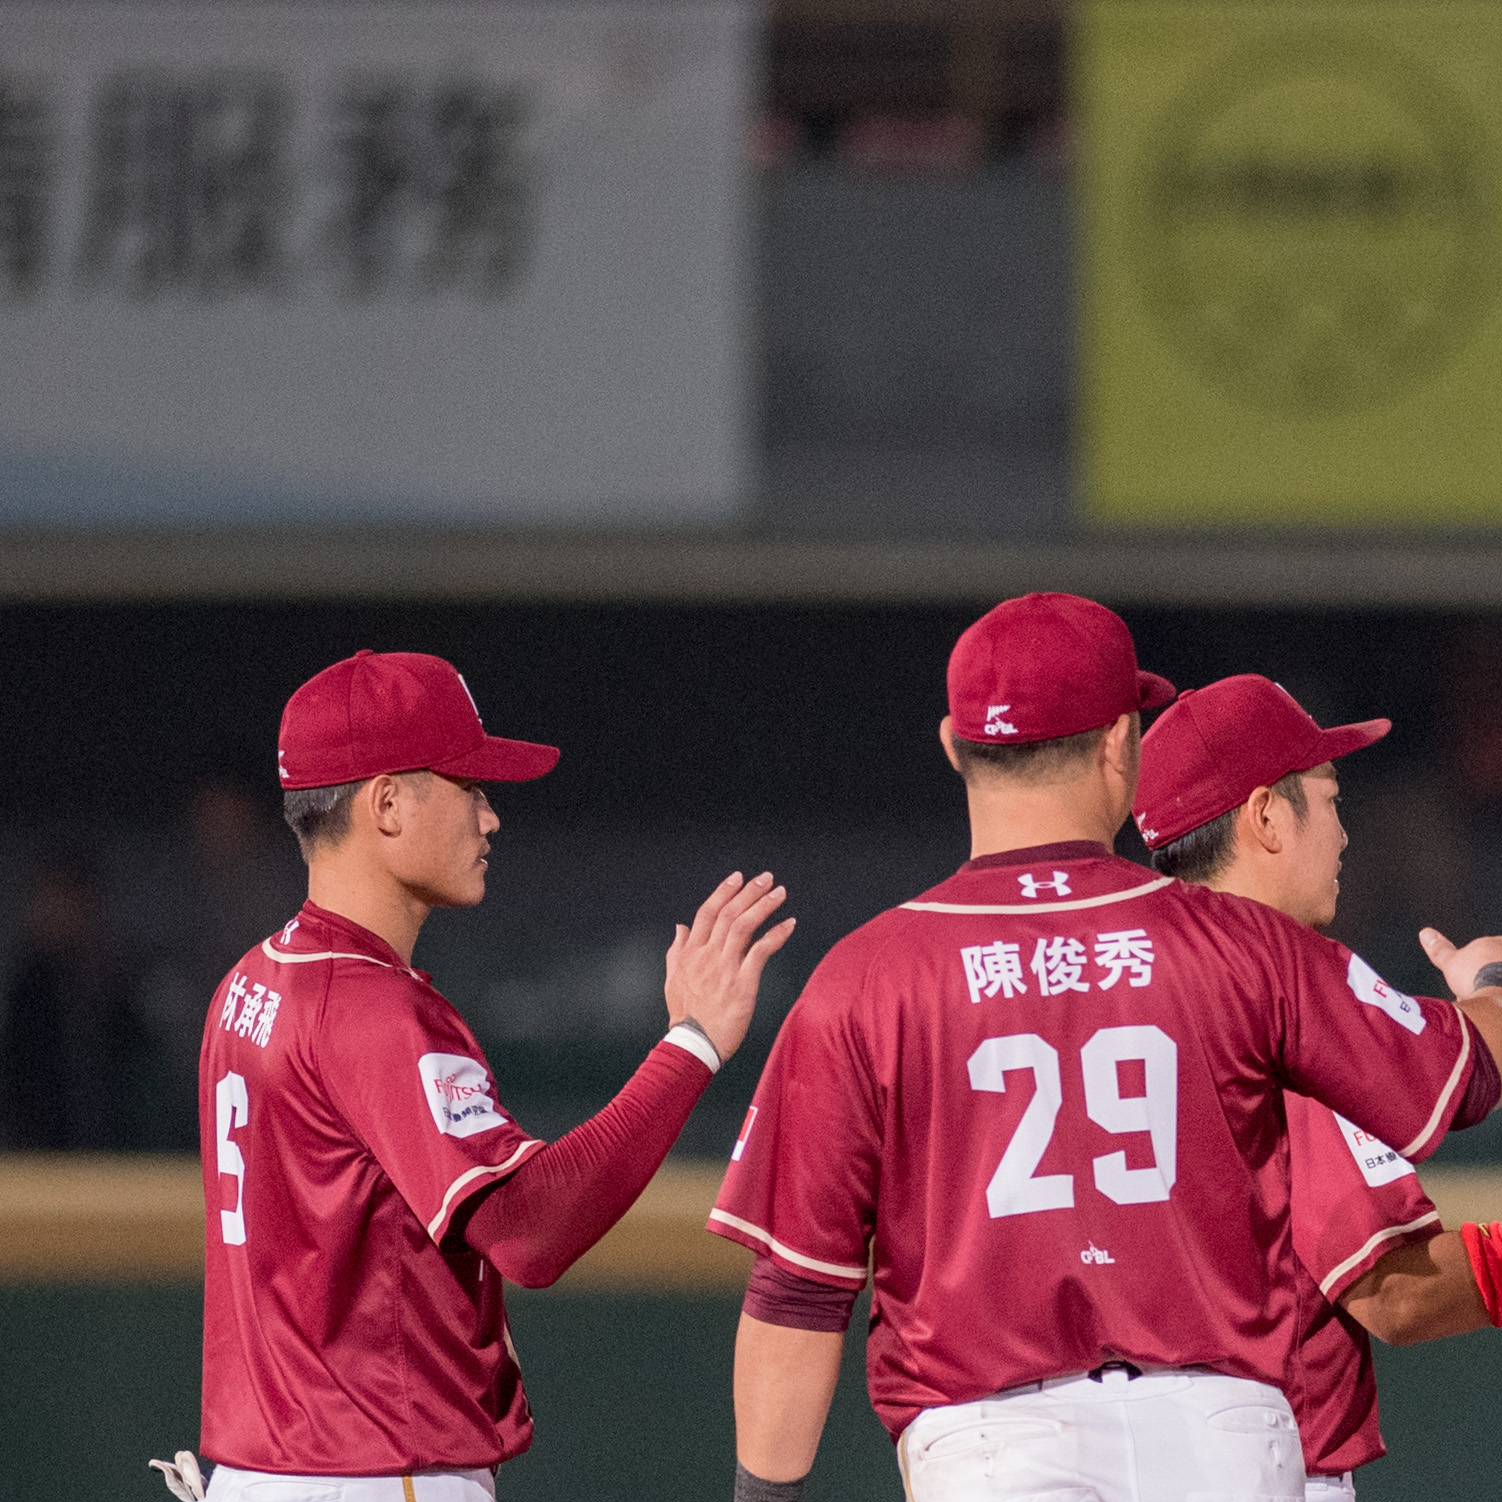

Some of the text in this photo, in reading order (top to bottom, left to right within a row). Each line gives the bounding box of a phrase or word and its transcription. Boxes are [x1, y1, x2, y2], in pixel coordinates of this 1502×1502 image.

[960, 928, 1156, 1005] 陳俊秀
[966, 1023, 1178, 1220] 29
